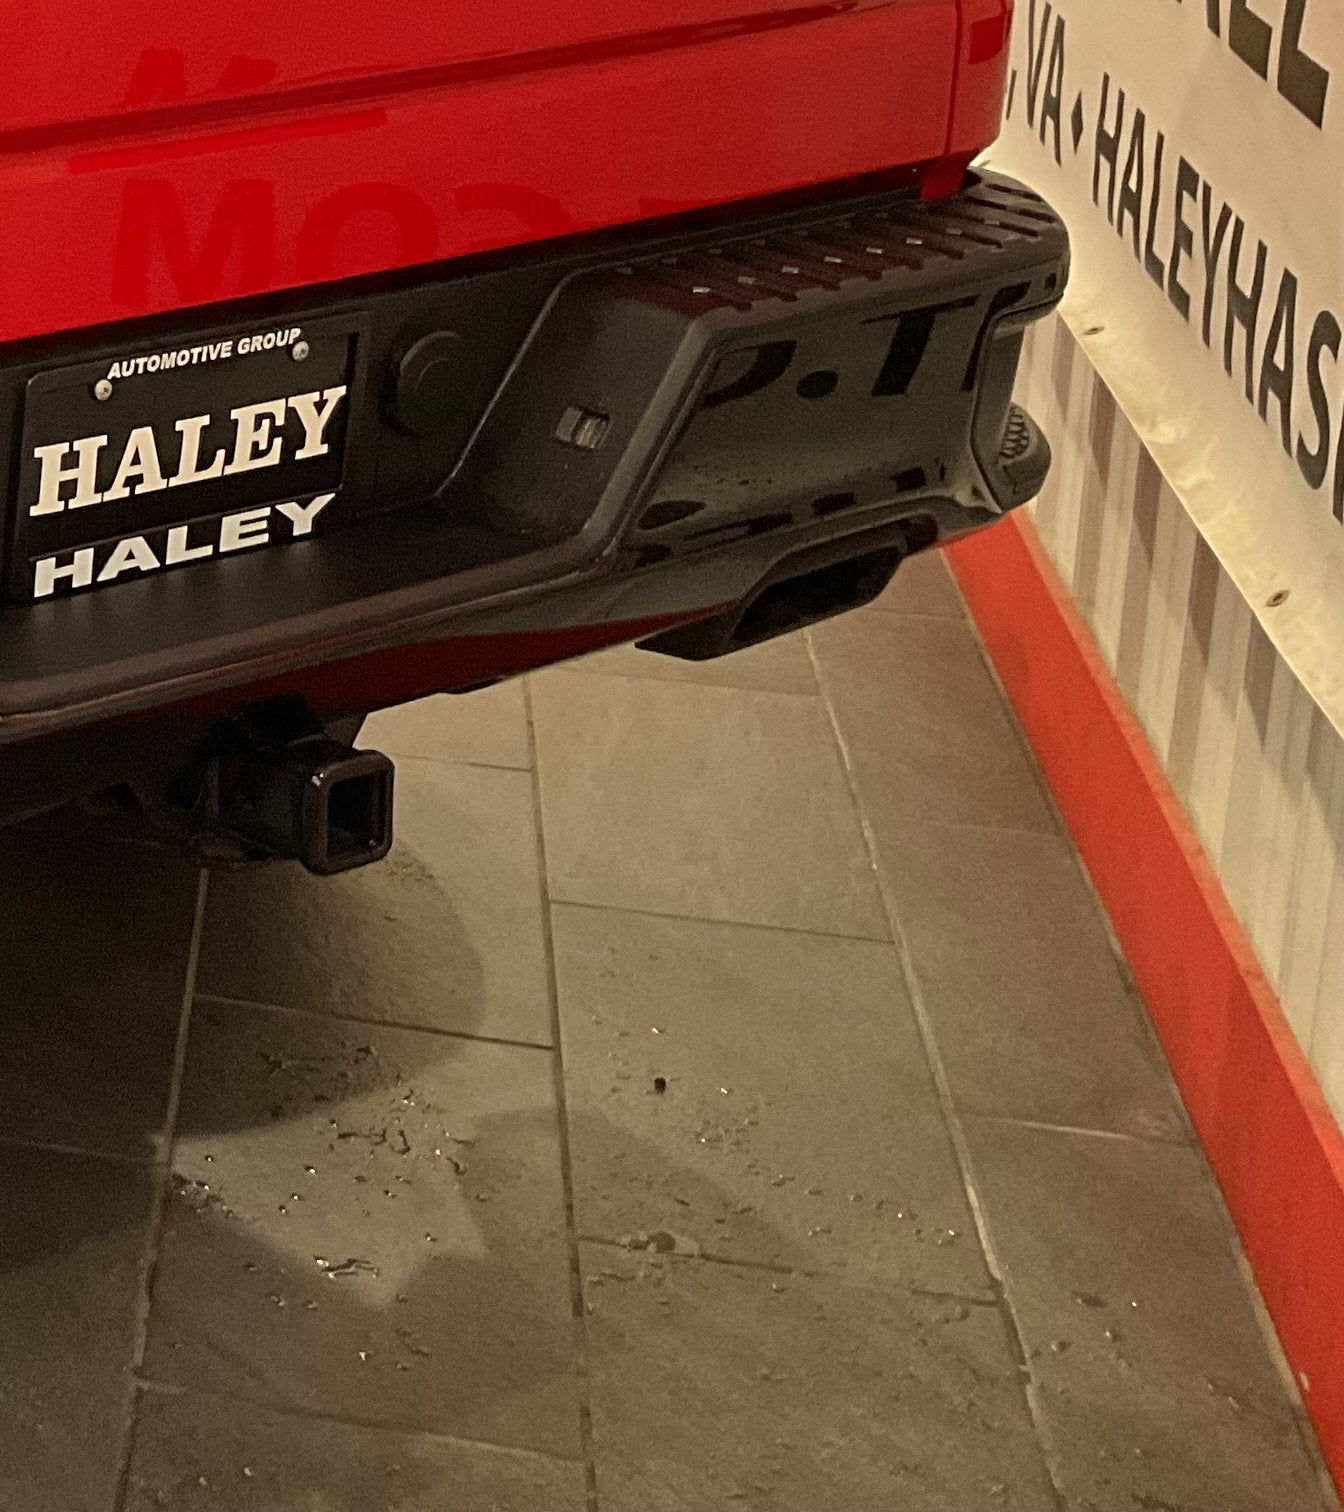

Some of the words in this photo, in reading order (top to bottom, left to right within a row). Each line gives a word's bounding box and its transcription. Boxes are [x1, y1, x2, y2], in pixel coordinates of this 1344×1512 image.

[107, 340, 234, 380] AUTOMOTIVE
[236, 327, 302, 356] GROUP
[29, 384, 348, 518] HALEY
[33, 492, 337, 598] HALEY
